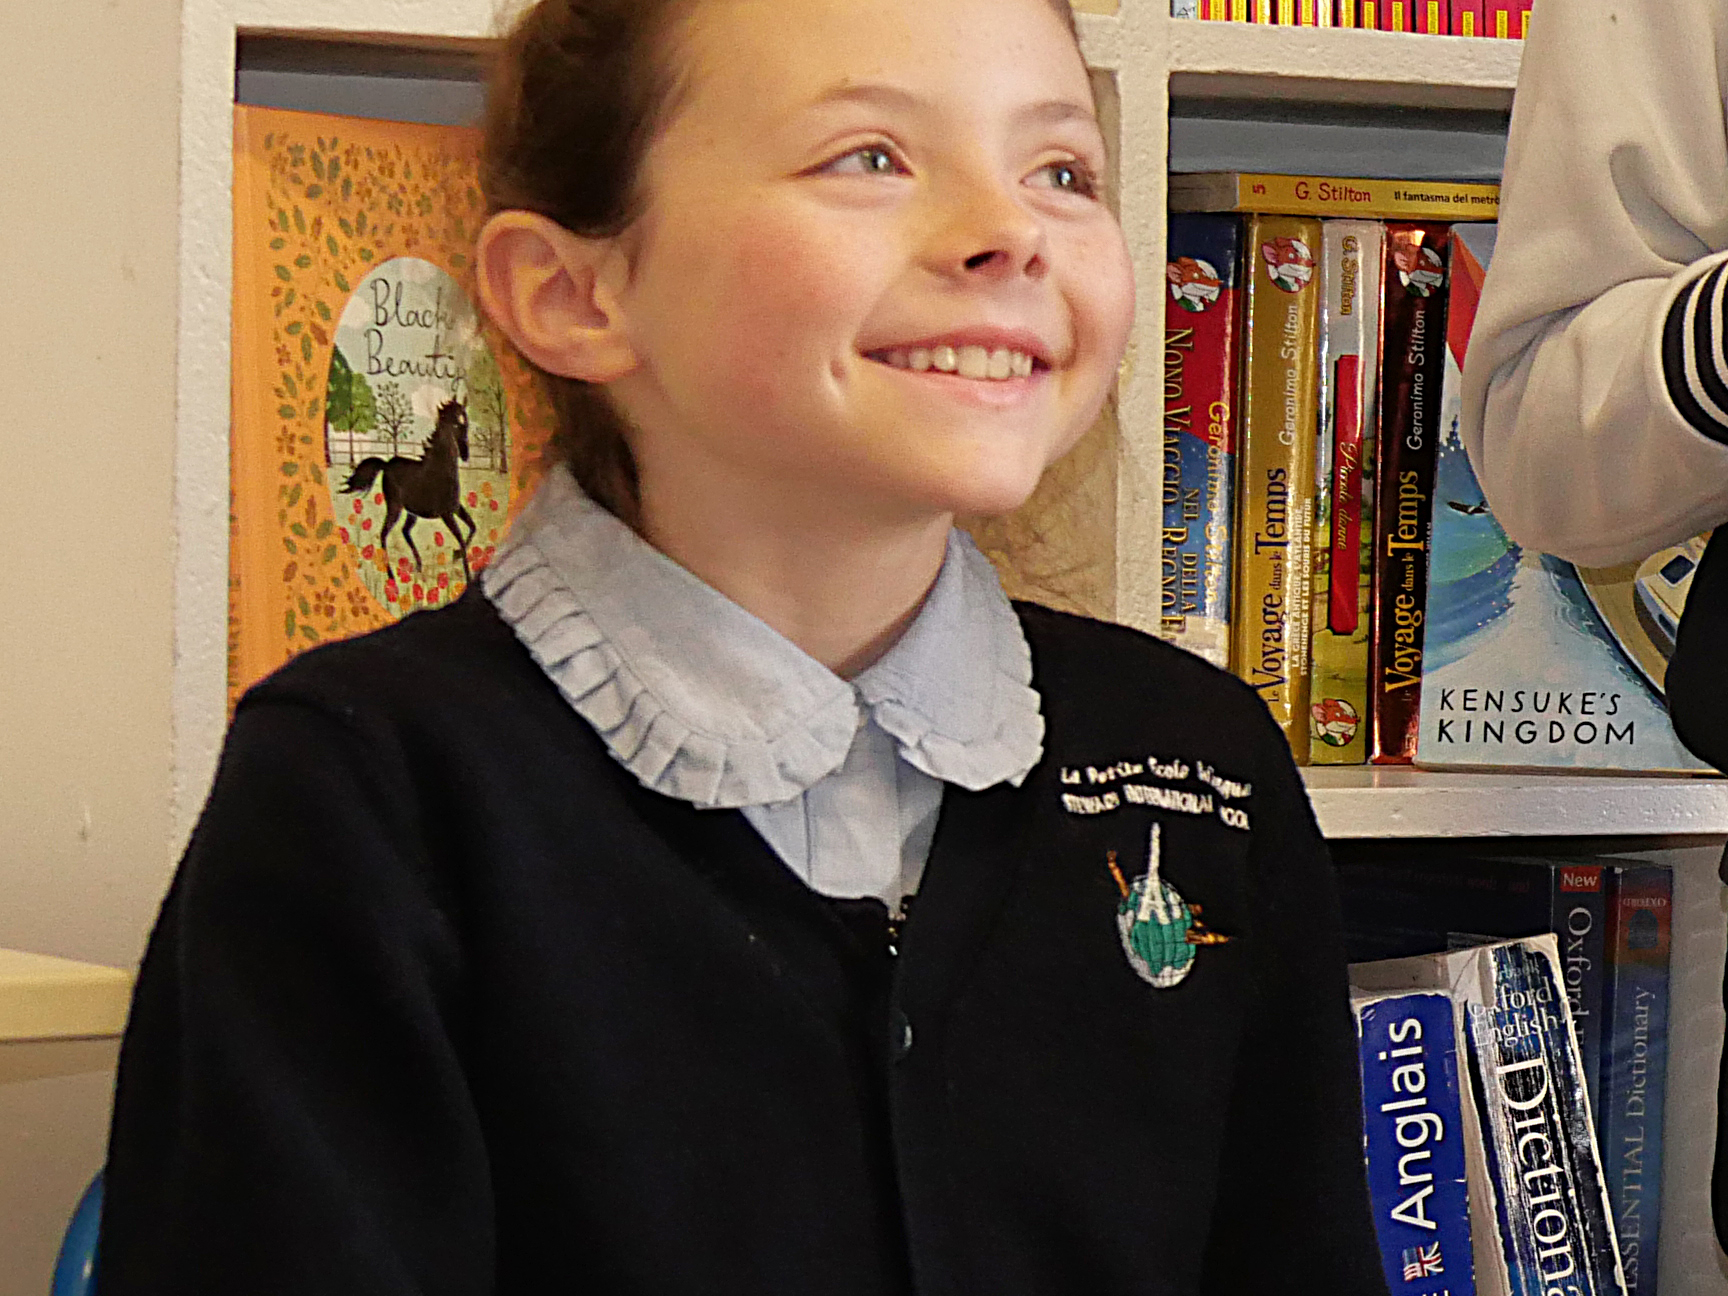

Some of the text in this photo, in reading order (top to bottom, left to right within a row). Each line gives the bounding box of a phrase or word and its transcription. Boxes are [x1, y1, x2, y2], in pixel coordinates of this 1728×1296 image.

[1295, 181, 1311, 201] G.
[1318, 183, 1371, 203] Stilton
[1403, 191, 1450, 203] fantasma
[1452, 193, 1468, 203] del
[370, 278, 453, 330] Black
[1339, 257, 1357, 315] Stilton
[366, 330, 469, 387] Beauty
[1279, 305, 1298, 446] Geronimo Stilton
[1406, 310, 1425, 450] Geronimo Stilton
[1201, 400, 1231, 604] Geronimo Stilton
[1255, 467, 1290, 555] Temps
[1181, 552, 1197, 610] DELLA
[1270, 562, 1282, 590] dans
[1384, 469, 1427, 693] Voyage dans le Temps
[1252, 592, 1289, 689] Voyage
[1440, 689, 1621, 716] KENSUKE'S
[1438, 720, 1636, 746] KINGDOM
[1562, 872, 1597, 887] New
[1626, 986, 1655, 1116] Dictionary
[1380, 1017, 1444, 1231] Anglais
